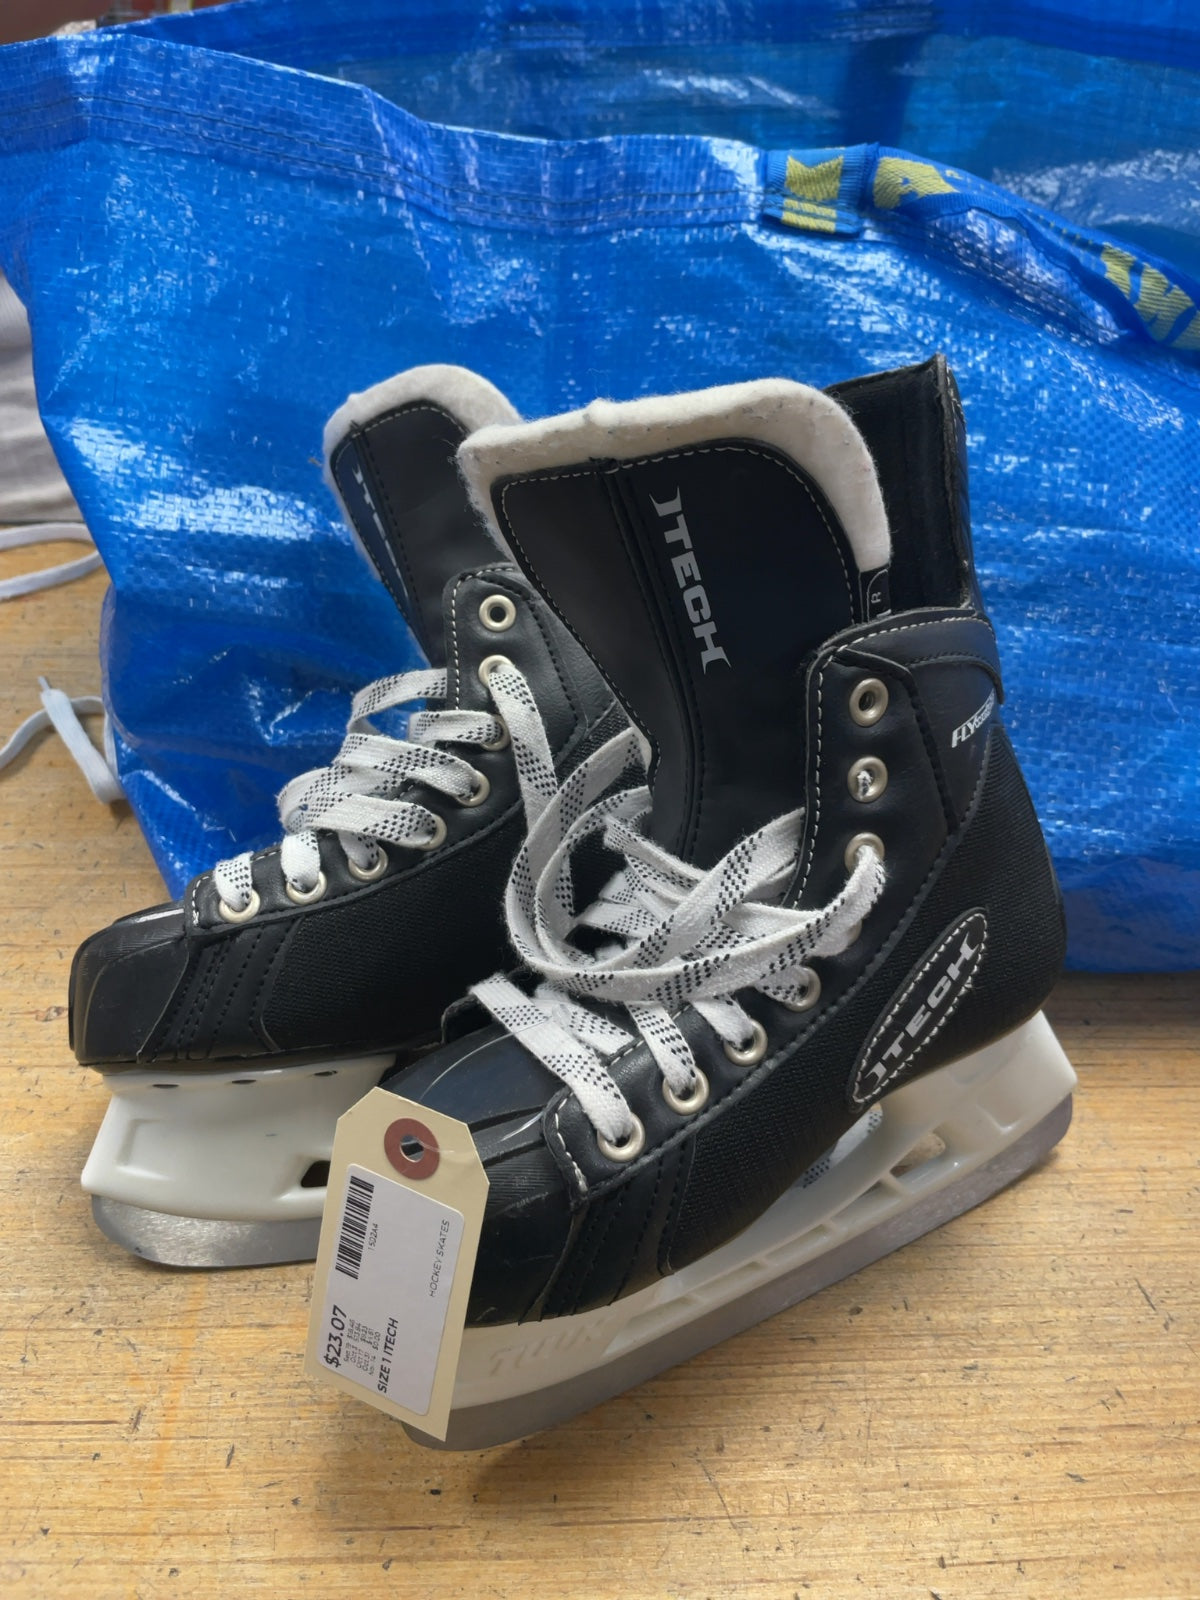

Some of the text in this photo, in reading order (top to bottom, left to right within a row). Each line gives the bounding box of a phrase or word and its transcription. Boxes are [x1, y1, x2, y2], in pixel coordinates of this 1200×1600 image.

[429, 1219, 450, 1297] HOCKEY SKATES
[324, 1304, 347, 1368] $23.07
[383, 1317, 399, 1356] ITECH
[377, 1364, 391, 1394] SIZE
